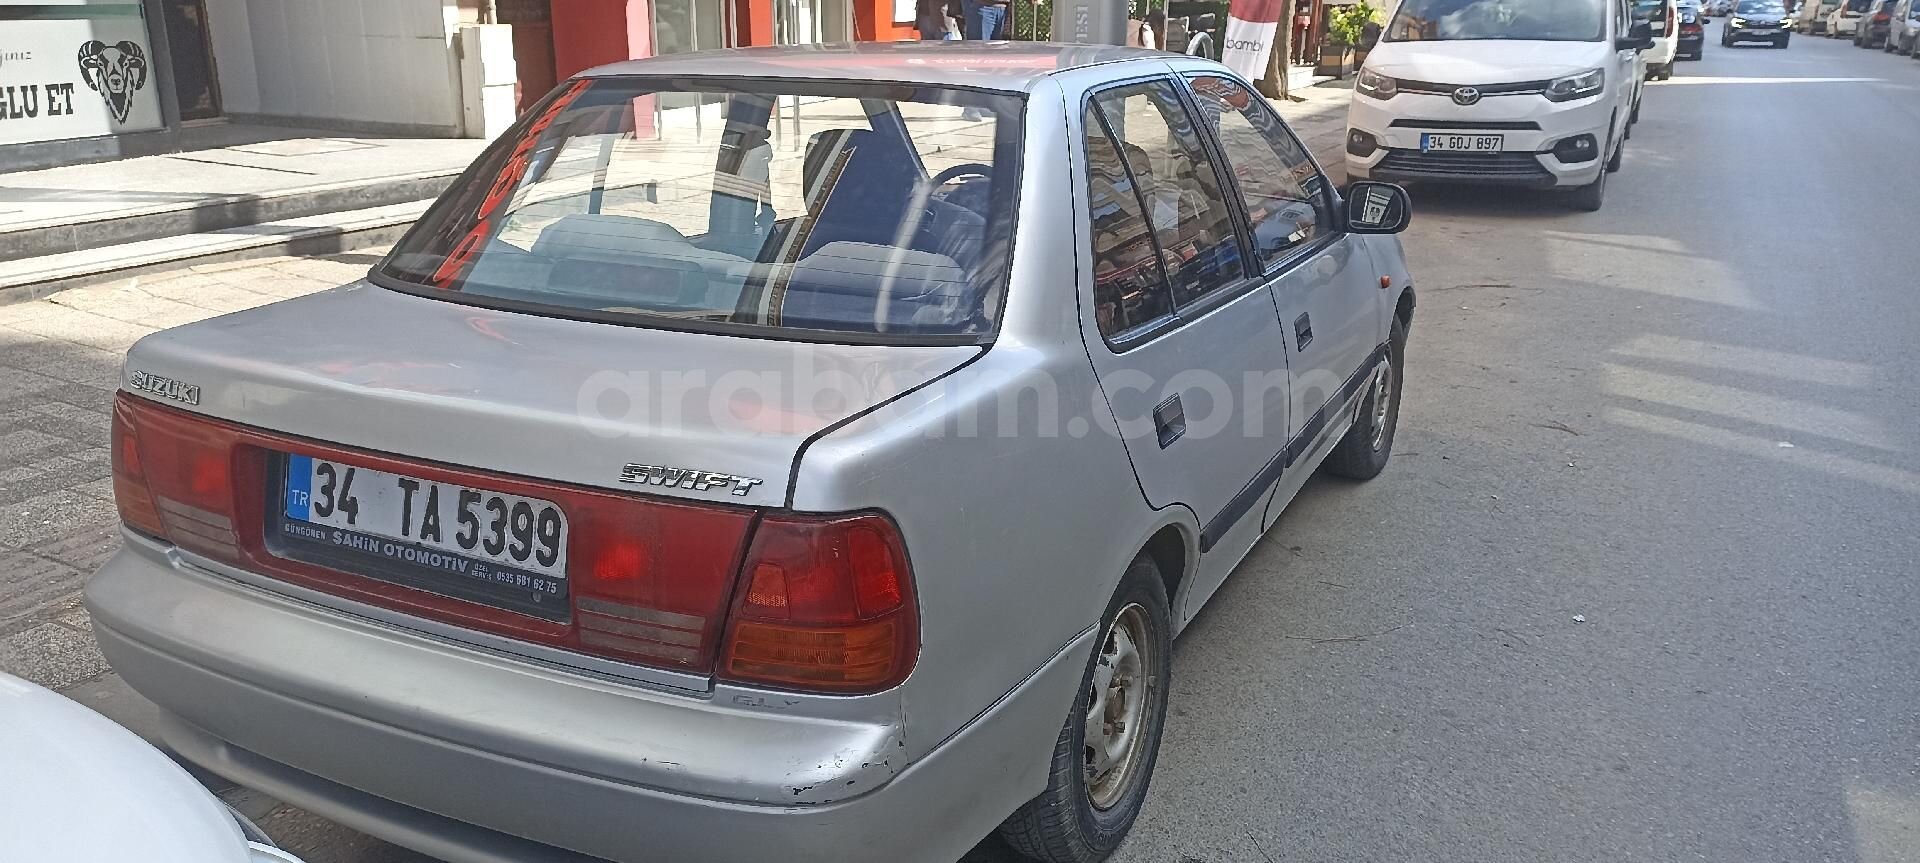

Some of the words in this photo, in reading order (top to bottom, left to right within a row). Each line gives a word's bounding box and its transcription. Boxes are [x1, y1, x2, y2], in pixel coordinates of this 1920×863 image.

[1226, 37, 1264, 51] bambi
[45, 82, 74, 116] ET
[1429, 136, 1443, 149] 34
[1477, 137, 1500, 150] 897
[130, 370, 200, 405] SUZUKI
[619, 463, 763, 496] SWIFT
[292, 489, 309, 507] TR
[314, 462, 359, 525] 34
[398, 477, 441, 543] TA
[455, 489, 562, 568] 5399
[546, 581, 557, 594] 75
